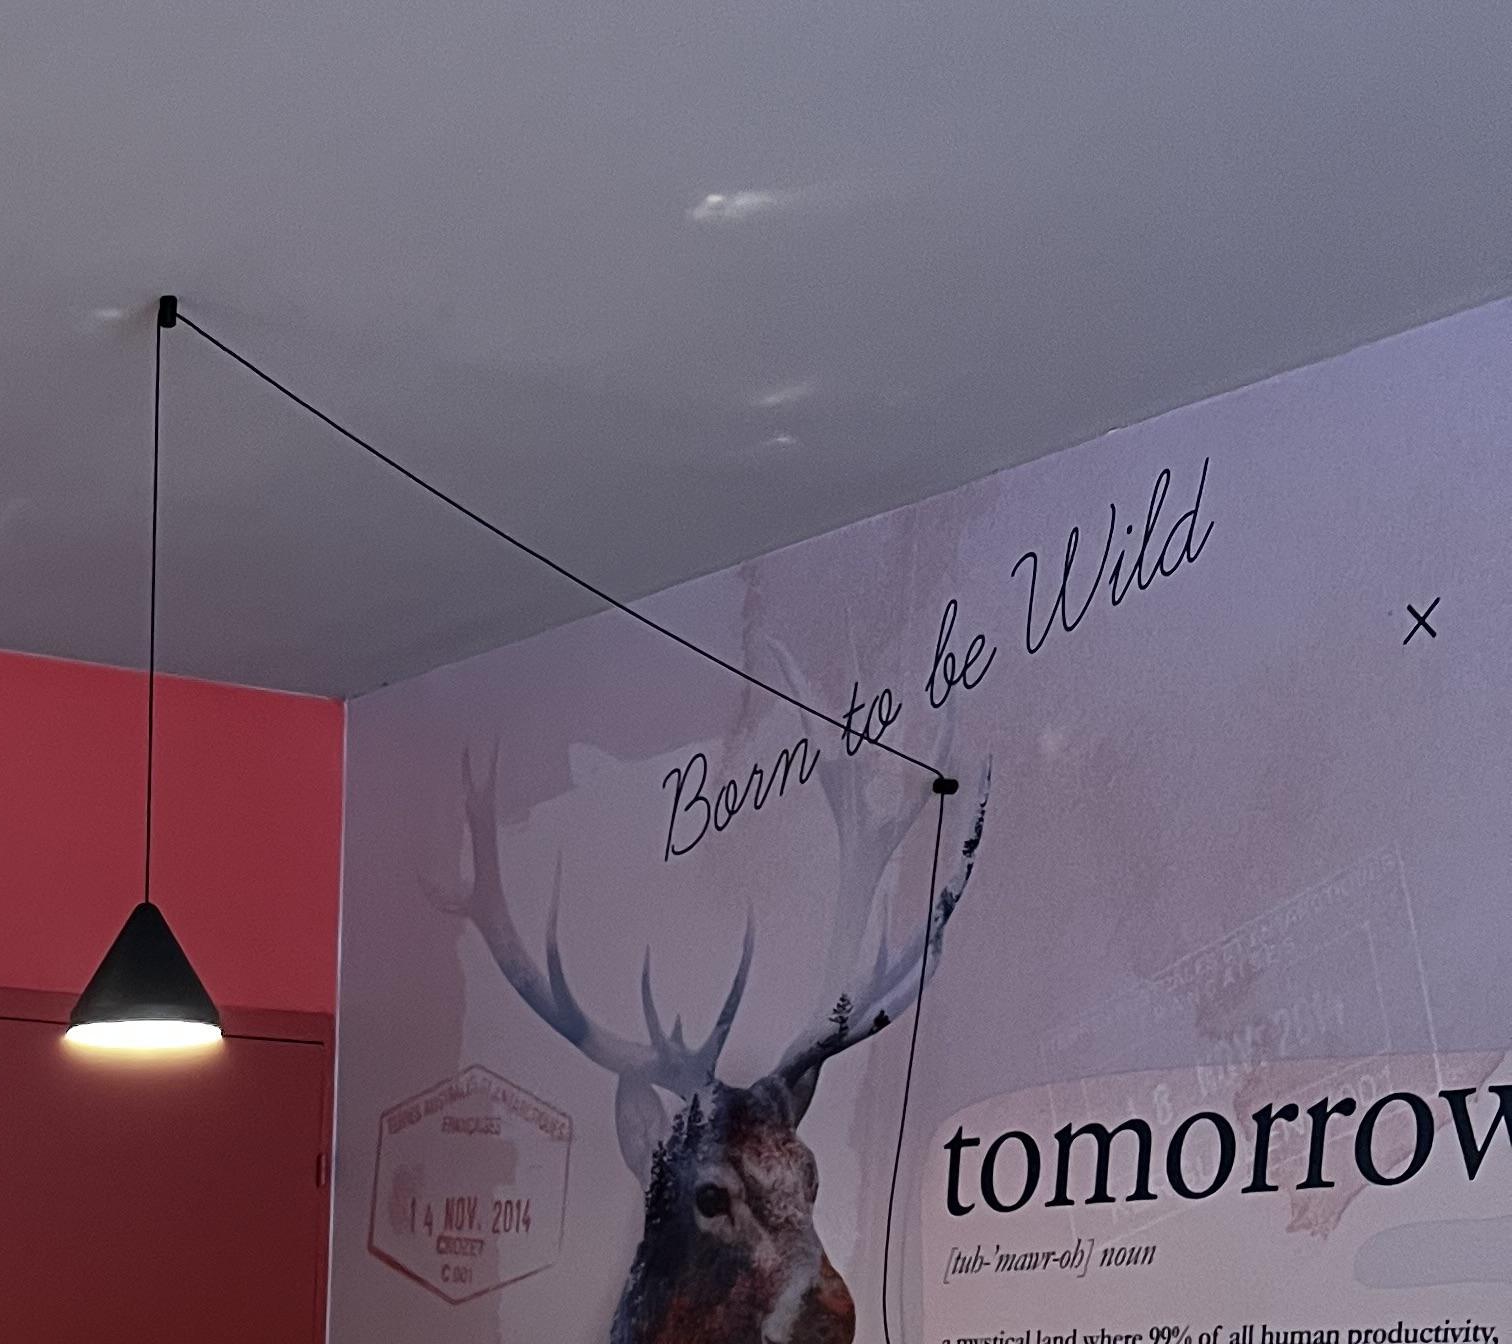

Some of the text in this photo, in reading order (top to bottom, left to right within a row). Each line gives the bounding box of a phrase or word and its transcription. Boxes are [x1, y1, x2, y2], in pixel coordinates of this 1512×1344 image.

[662, 457, 1215, 862] Born to be Wild
[943, 1083, 1512, 1217] tomorrow
[491, 1199, 532, 1234] 2014
[1099, 1245, 1157, 1268] noun
